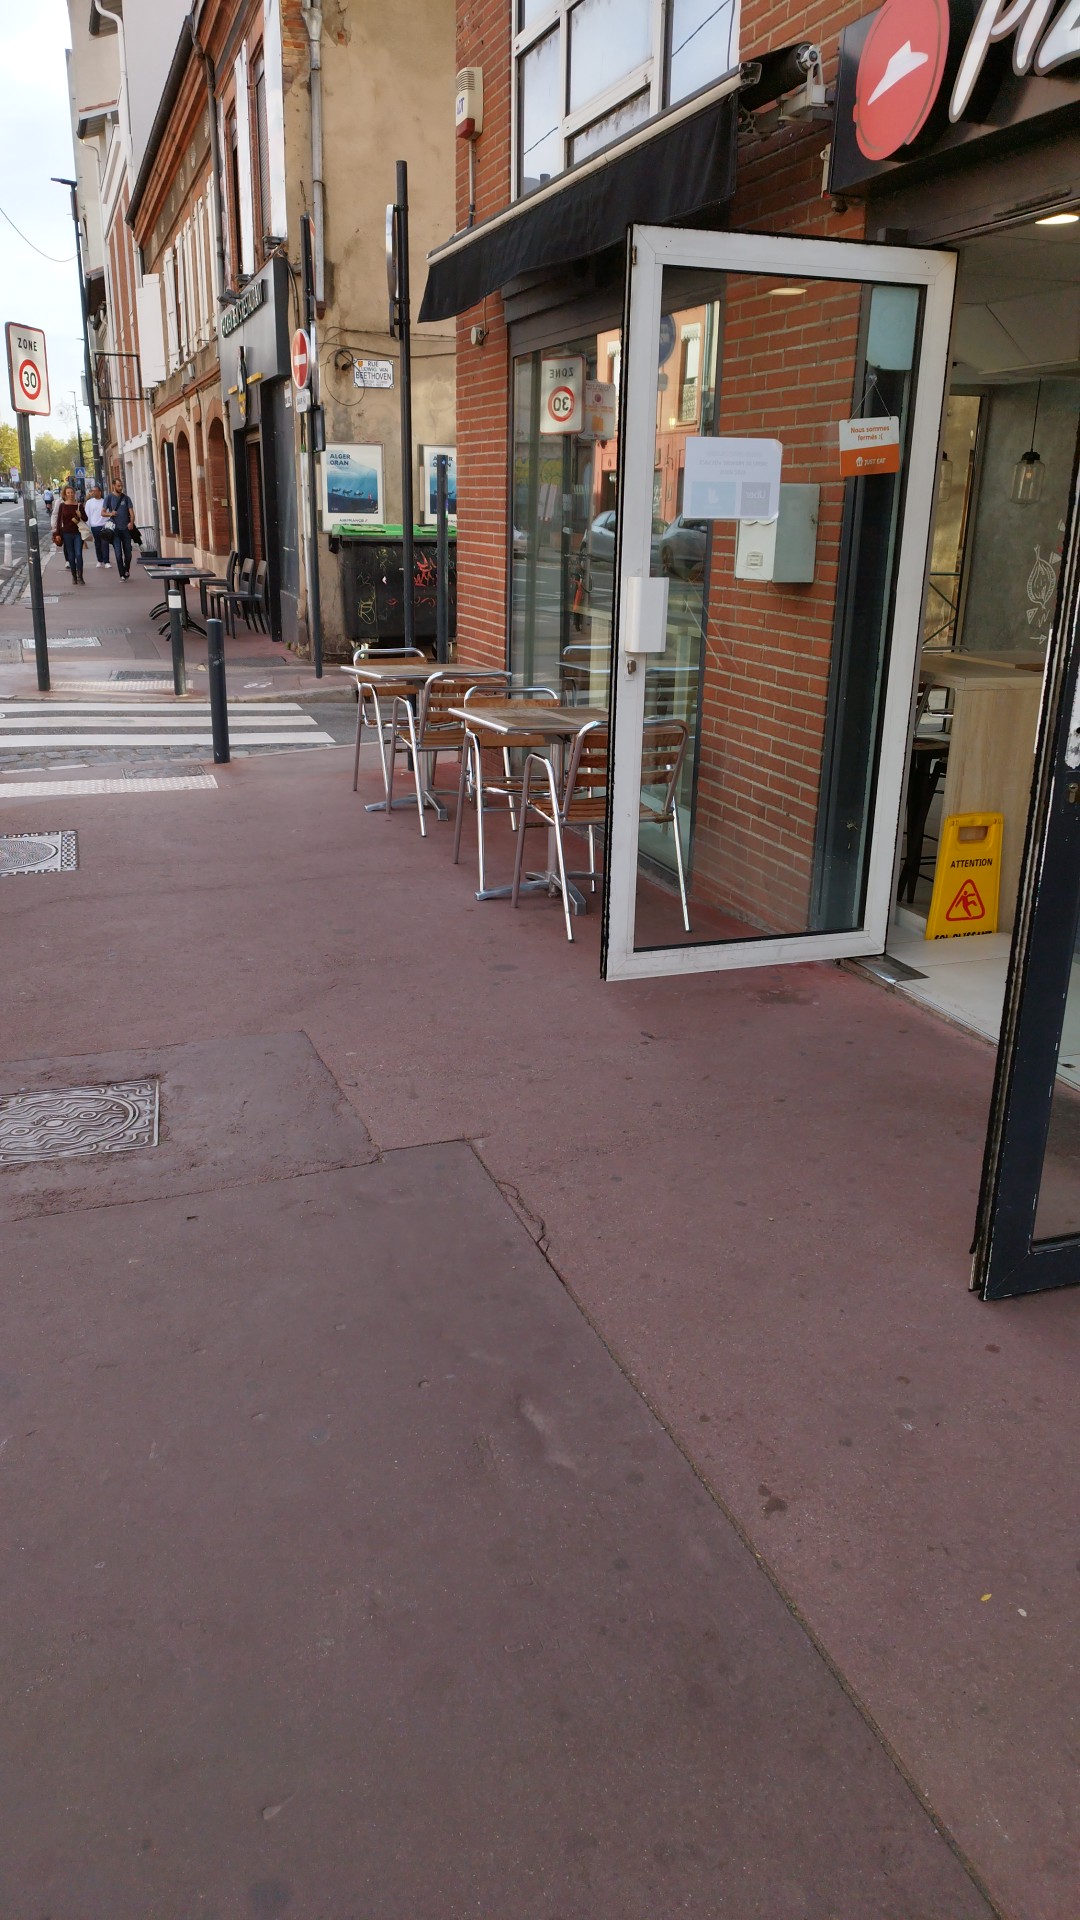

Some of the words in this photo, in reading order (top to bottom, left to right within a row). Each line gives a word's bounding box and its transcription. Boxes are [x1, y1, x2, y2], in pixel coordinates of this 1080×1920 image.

[17, 337, 38, 352] ZONE
[23, 370, 37, 389] 30
[356, 372, 391, 380] BEETHOVEN
[950, 858, 993, 868] ATTENTION
